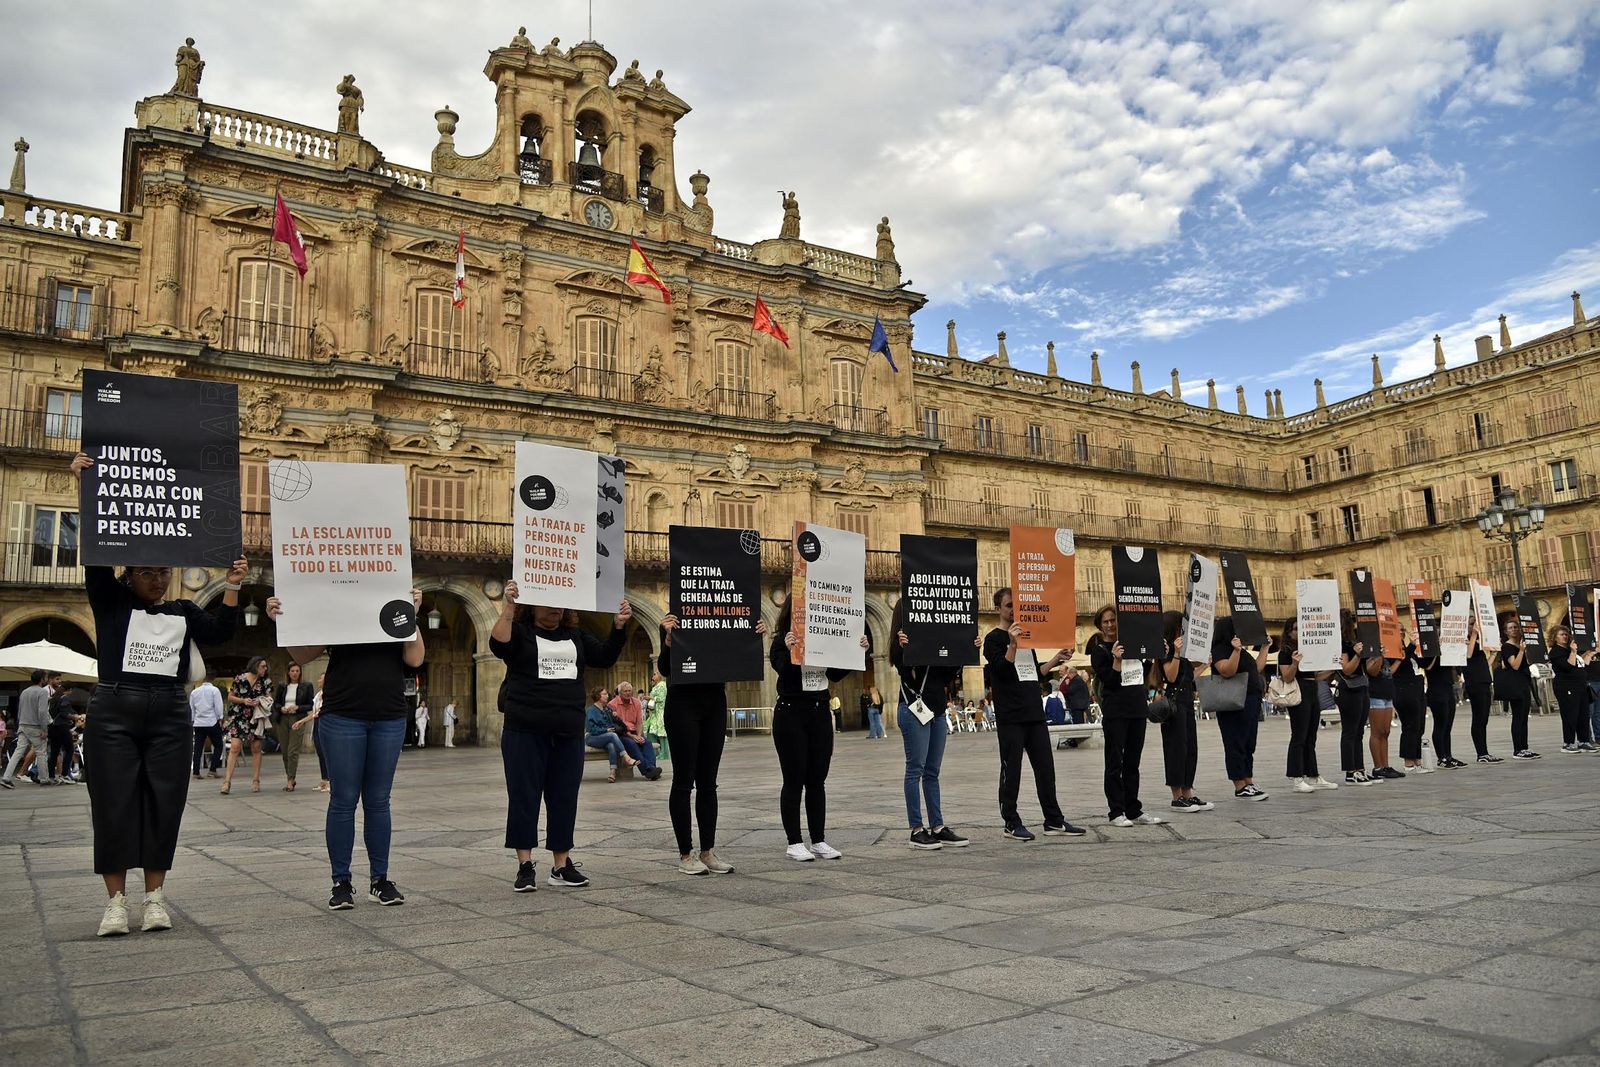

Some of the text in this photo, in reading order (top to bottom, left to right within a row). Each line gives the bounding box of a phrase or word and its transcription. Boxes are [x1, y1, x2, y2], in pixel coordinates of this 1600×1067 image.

[98, 445, 167, 466] JUNTOS,
[98, 464, 176, 482] PODEMOS
[97, 483, 203, 500] ACABAR CON
[98, 501, 201, 519] LA TRATA DE
[98, 520, 192, 536] PERSONAS.
[525, 516, 585, 534] LA TRATA DE
[292, 527, 392, 538] LA ESCLAVITUD
[525, 530, 576, 545] PERSONAS
[282, 541, 402, 556] ESTÁ PRESENTE EN
[525, 544, 578, 560] OCURRE EN
[290, 561, 397, 572] TODO EL MUNDO.
[524, 559, 576, 574] NUESTRAS
[681, 566, 722, 576] SE ESTIMA
[1027, 563, 1056, 571] PERSONAS
[524, 572, 576, 588] CIUDADES.
[681, 580, 735, 590] QUE LA TRATA
[910, 574, 970, 586] ABOLIENDO LA
[810, 580, 852, 593] YO CAMINO POR
[681, 591, 742, 603] GENERA MÁS DE
[818, 593, 851, 604] ESTUDIANTE
[908, 587, 972, 599] ESCLAVITUD EN
[681, 606, 750, 615] 126 MIL MILLONES
[809, 603, 862, 617] QUE FUE ENGAÑADO
[911, 600, 970, 611] TODO LUGAR Y
[682, 618, 751, 628] DE EUROS AL AÑO.
[815, 615, 846, 626] EXPLOTADO
[909, 613, 974, 624] PARA SIEMPRE.
[809, 626, 851, 638] SEXUALMENTE.
[130, 642, 169, 652] ABOLIENDO
[130, 648, 172, 658] ESCLAVITUD
